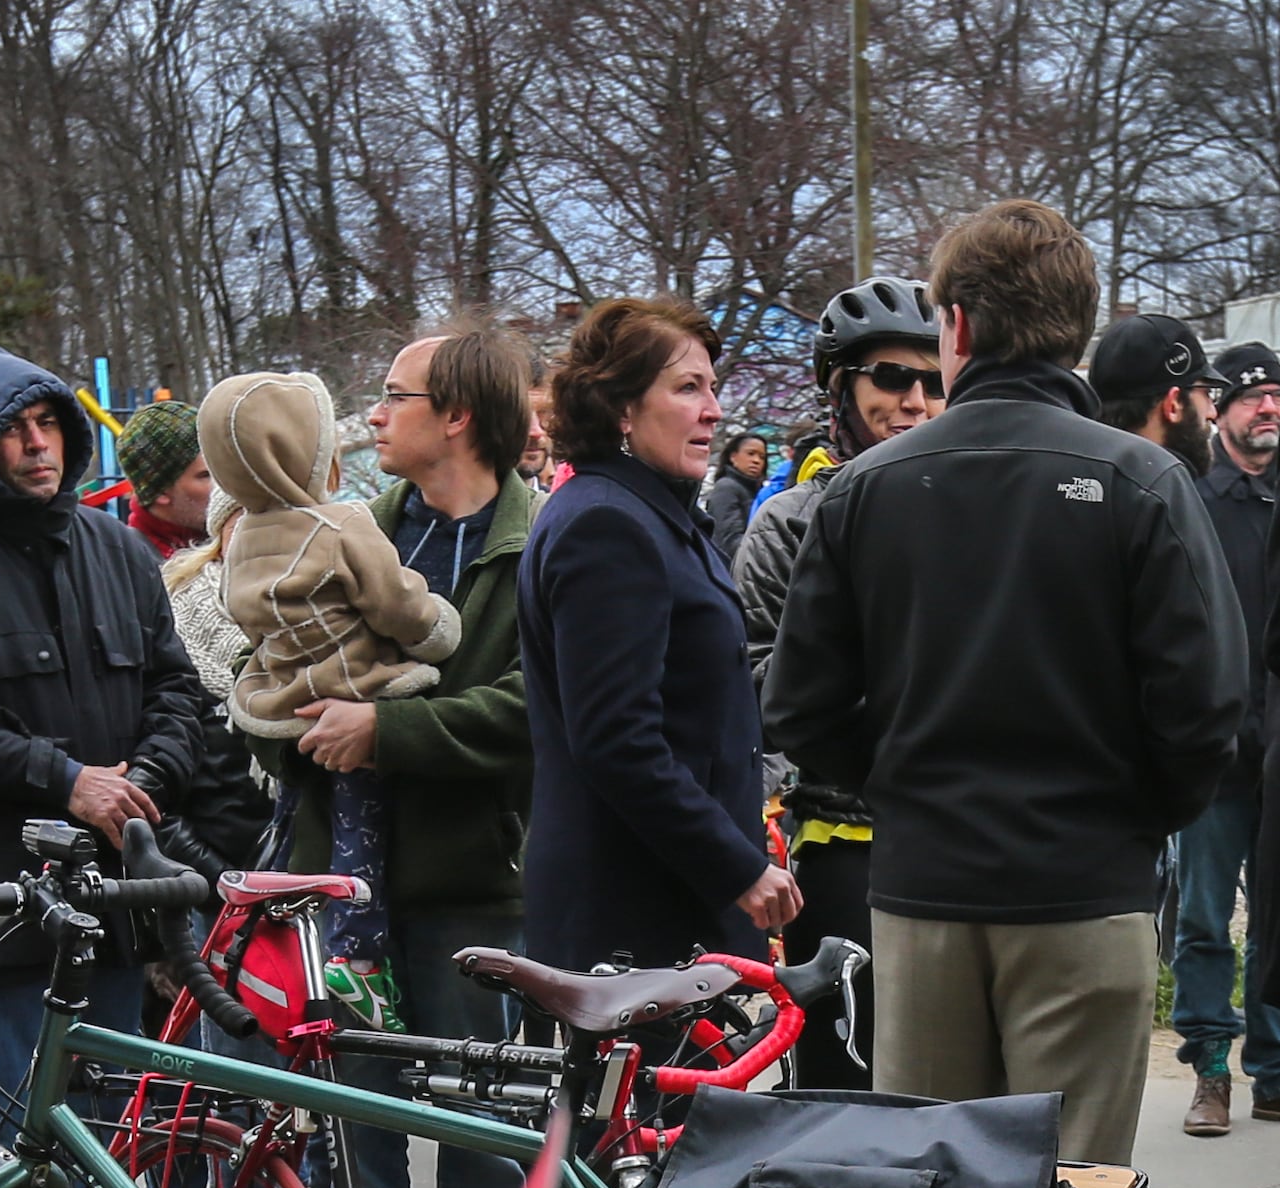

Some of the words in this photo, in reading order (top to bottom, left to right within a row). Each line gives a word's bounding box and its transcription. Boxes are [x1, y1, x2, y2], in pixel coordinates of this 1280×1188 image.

[1072, 476, 1090, 487] THE
[1057, 483, 1088, 494] NORTH
[1065, 491, 1088, 501] FACE
[151, 1051, 195, 1076] ROVE
